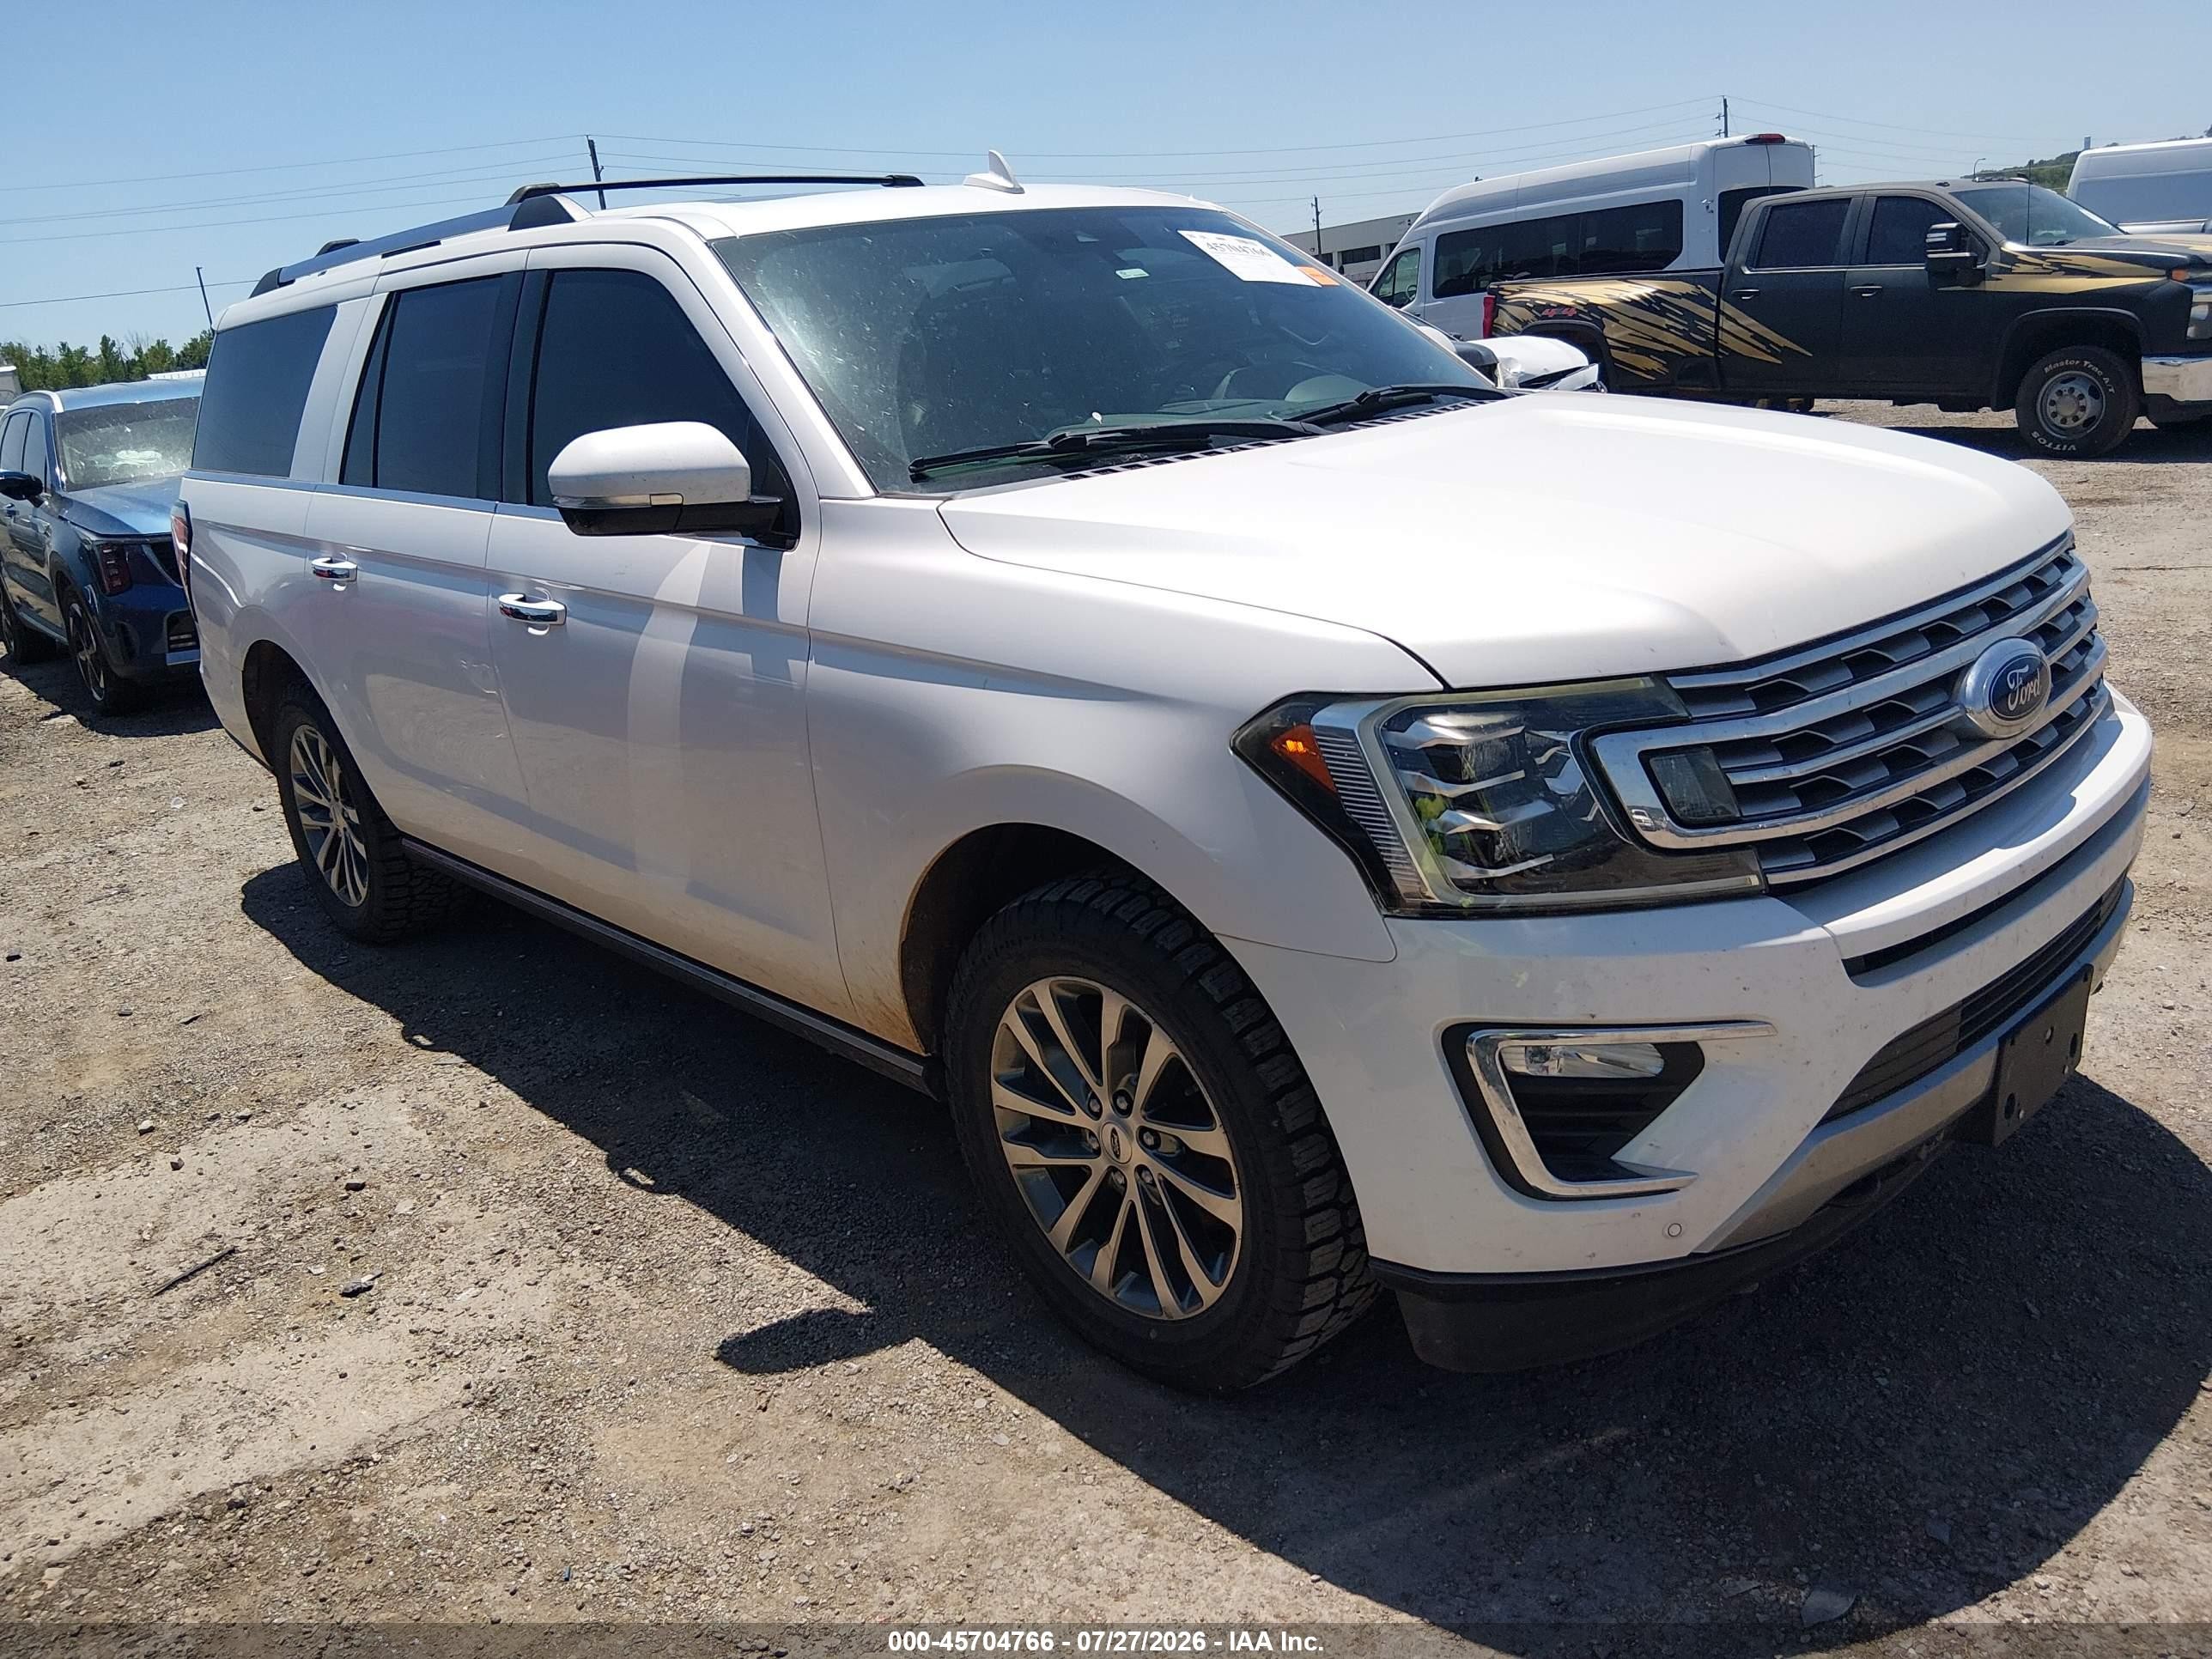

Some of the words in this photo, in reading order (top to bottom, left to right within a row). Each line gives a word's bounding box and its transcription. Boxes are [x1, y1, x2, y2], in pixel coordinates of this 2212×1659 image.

[2044, 359, 2081, 374] Master
[2083, 361, 2103, 377] Trac
[2031, 430, 2077, 451] VITOS
[2006, 665, 2041, 711] Ford
